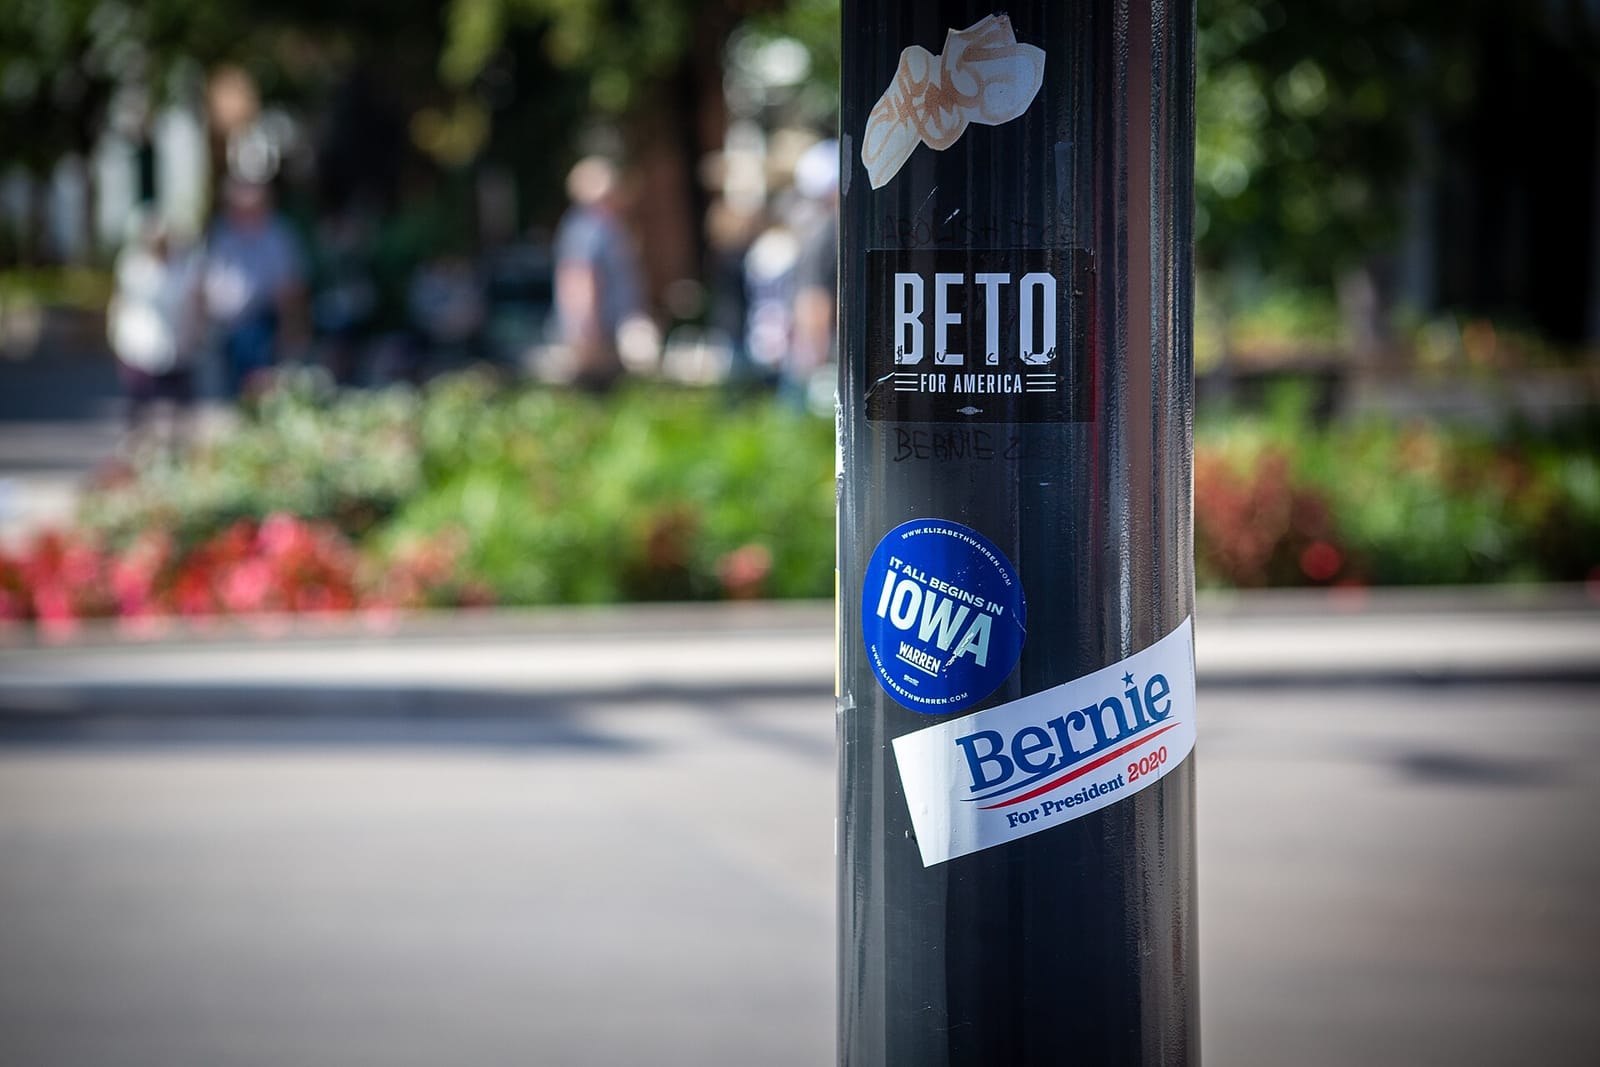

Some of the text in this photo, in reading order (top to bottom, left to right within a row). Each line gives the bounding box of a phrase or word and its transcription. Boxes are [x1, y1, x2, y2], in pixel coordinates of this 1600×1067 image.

[894, 272, 1057, 366] BETO
[920, 373, 1023, 394] FOR AMERICA
[893, 428, 994, 462] BERNIE
[889, 556, 1004, 616] IT ALL BEGINS IN
[901, 527, 1012, 587] WWW.ELIZABETHWARREN.COM
[876, 569, 993, 667] IOWA
[871, 644, 969, 705] WWW.ELIZABETHWARREN.COM
[899, 641, 941, 674] WARREN
[956, 670, 1172, 793] Bernie
[1006, 746, 1168, 829] For President 2020
